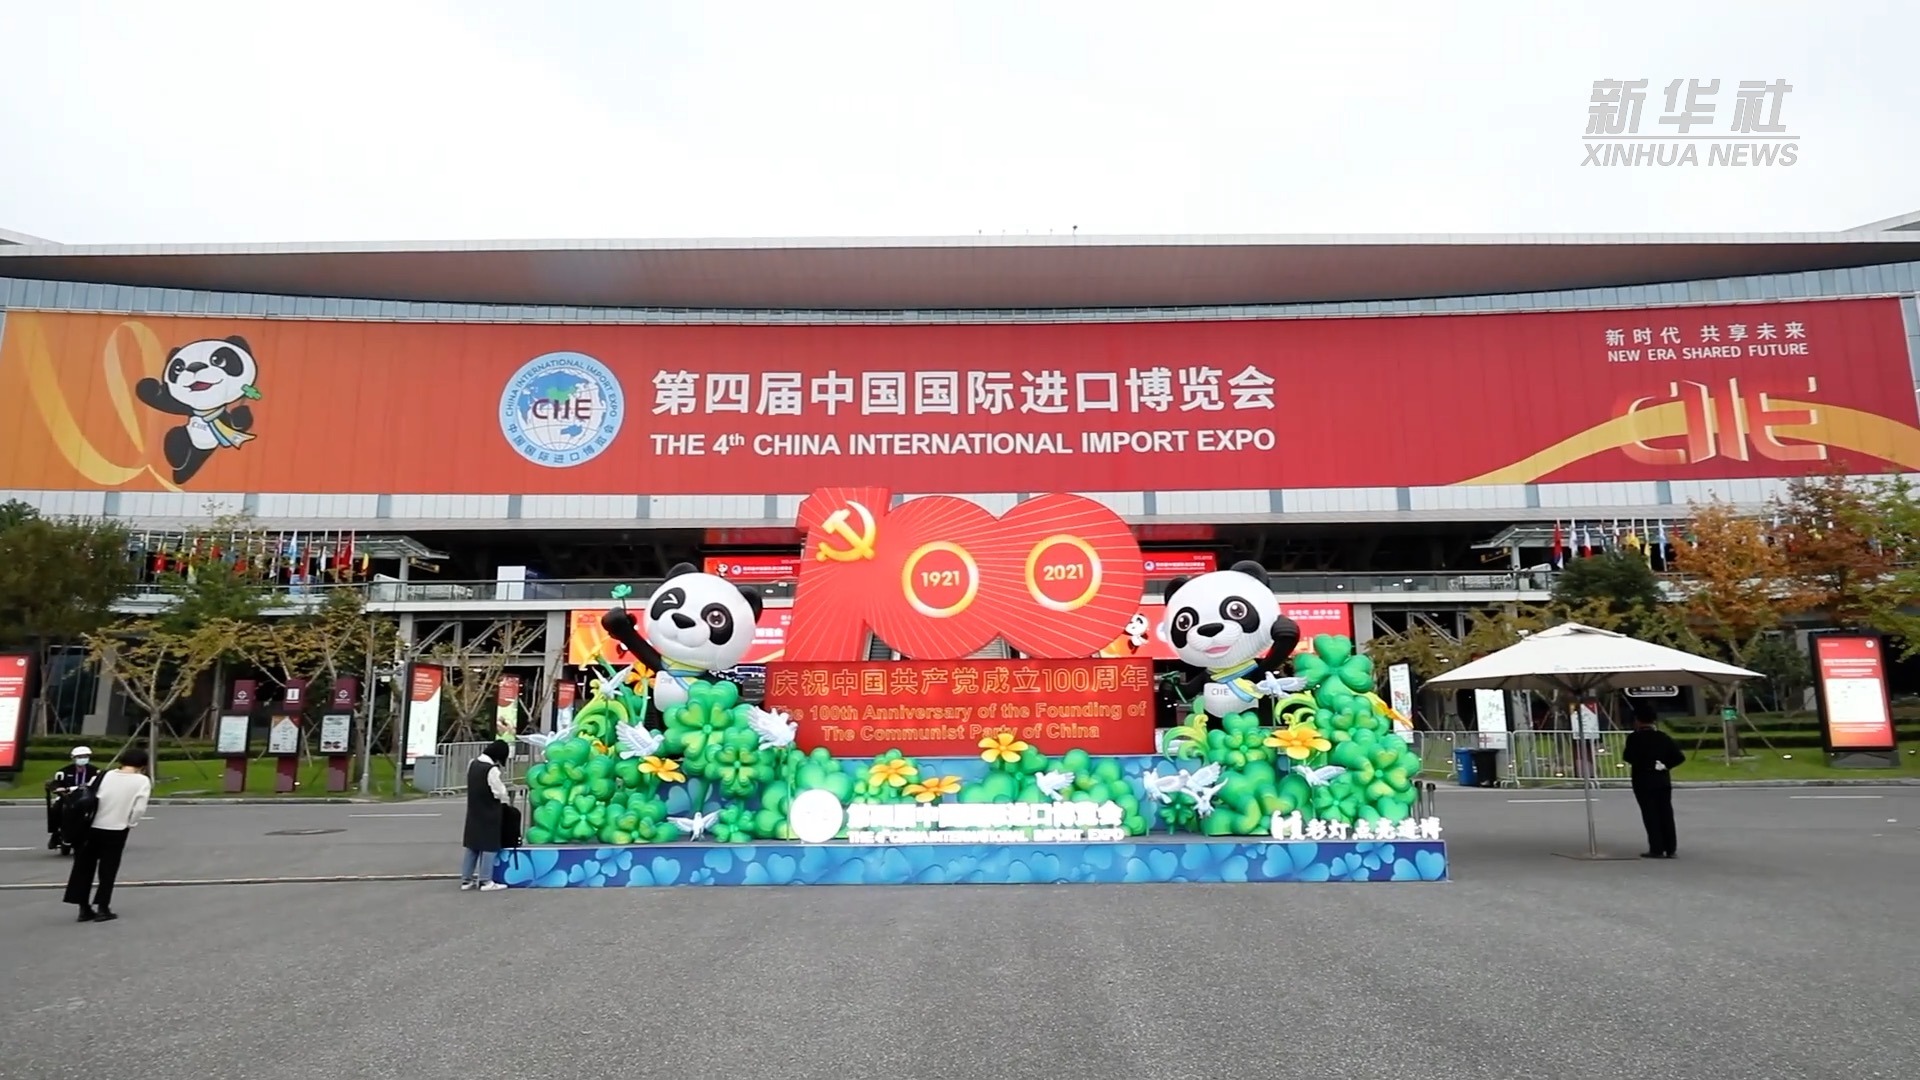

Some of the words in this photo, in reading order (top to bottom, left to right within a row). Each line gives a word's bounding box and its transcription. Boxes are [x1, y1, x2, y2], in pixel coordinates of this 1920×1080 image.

[1605, 327, 1681, 347] 新时代
[1700, 321, 1806, 343] 共享未来
[1607, 350, 1641, 363] NEW
[1647, 348, 1677, 361] ERA
[1682, 345, 1742, 360] SHARED
[1749, 342, 1809, 357] FUTURE
[505, 389, 519, 417] CHINA
[515, 359, 585, 388] INTERNATIONAL
[586, 364, 613, 392] IMPORT
[608, 393, 618, 418] EXPO
[651, 365, 1276, 416] 第四届中国国际进口博览会
[532, 398, 592, 420] CIIE
[650, 433, 705, 456] THE
[712, 432, 745, 456] 4th
[753, 433, 841, 456] CHINA
[850, 432, 1073, 456] INTERNATIONAL
[1082, 430, 1189, 454] IMPORT
[1197, 428, 1276, 452] EXPO
[920, 569, 961, 588] 1921
[1043, 563, 1084, 582] 2021
[770, 664, 1149, 697] 庆祝中国共产党成立100周年
[809, 704, 859, 721] 100th
[862, 704, 973, 723] Anniversary
[977, 703, 997, 719] of
[1000, 703, 1031, 719] the
[1035, 701, 1123, 721] Founding
[1127, 701, 1147, 717] of
[821, 725, 856, 742] The
[860, 724, 965, 742] Communist
[1022, 723, 1043, 739] of
[1046, 722, 1100, 739] China
